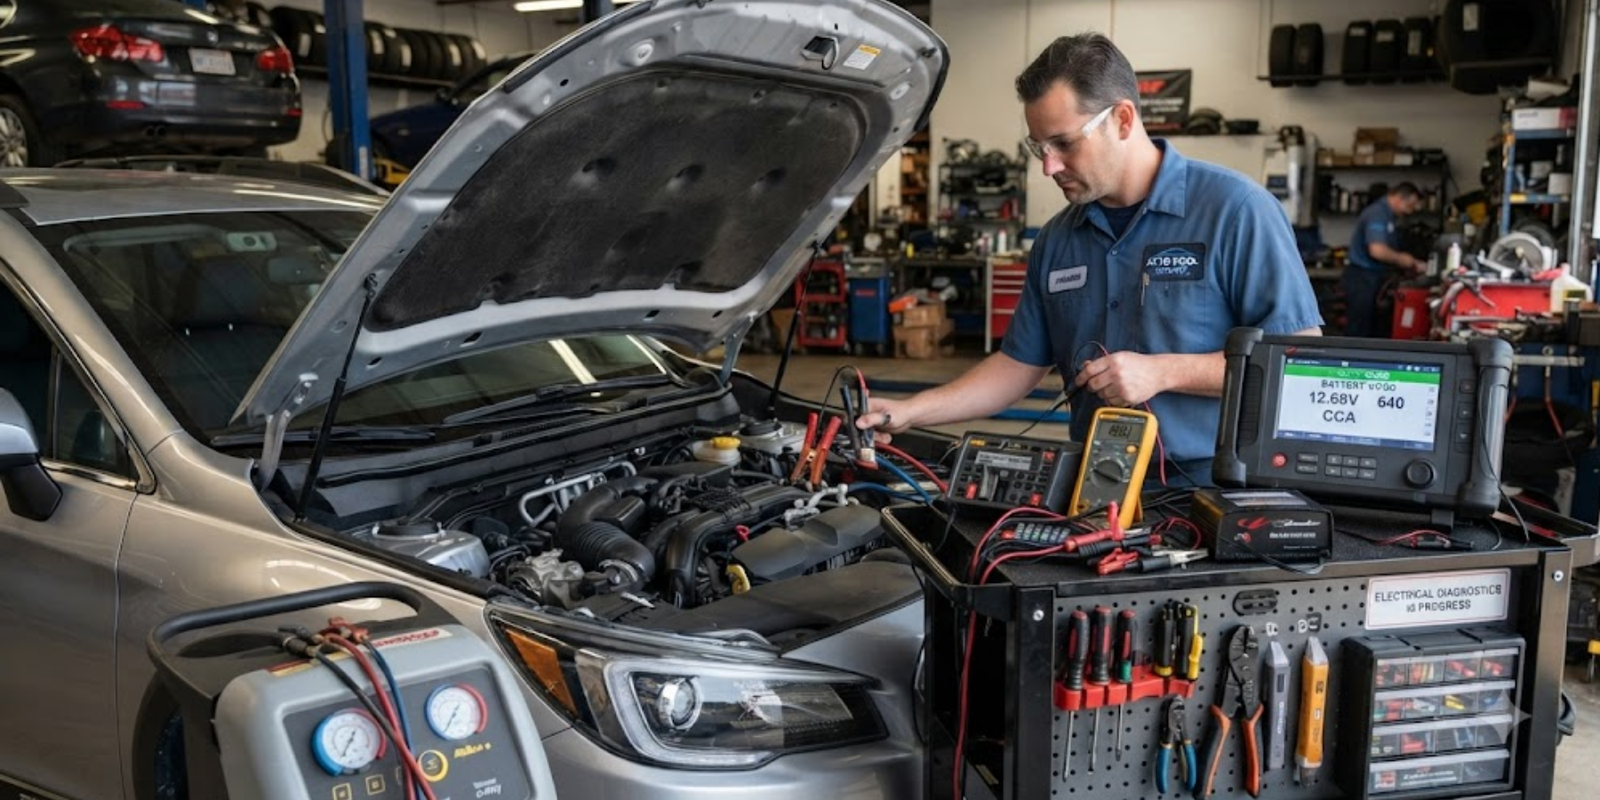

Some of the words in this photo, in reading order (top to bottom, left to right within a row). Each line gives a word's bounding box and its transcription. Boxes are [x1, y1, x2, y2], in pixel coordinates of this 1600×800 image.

[1309, 391, 1359, 406] 12.68V
[1377, 396, 1405, 409] 640
[1322, 409, 1356, 423] CCA
